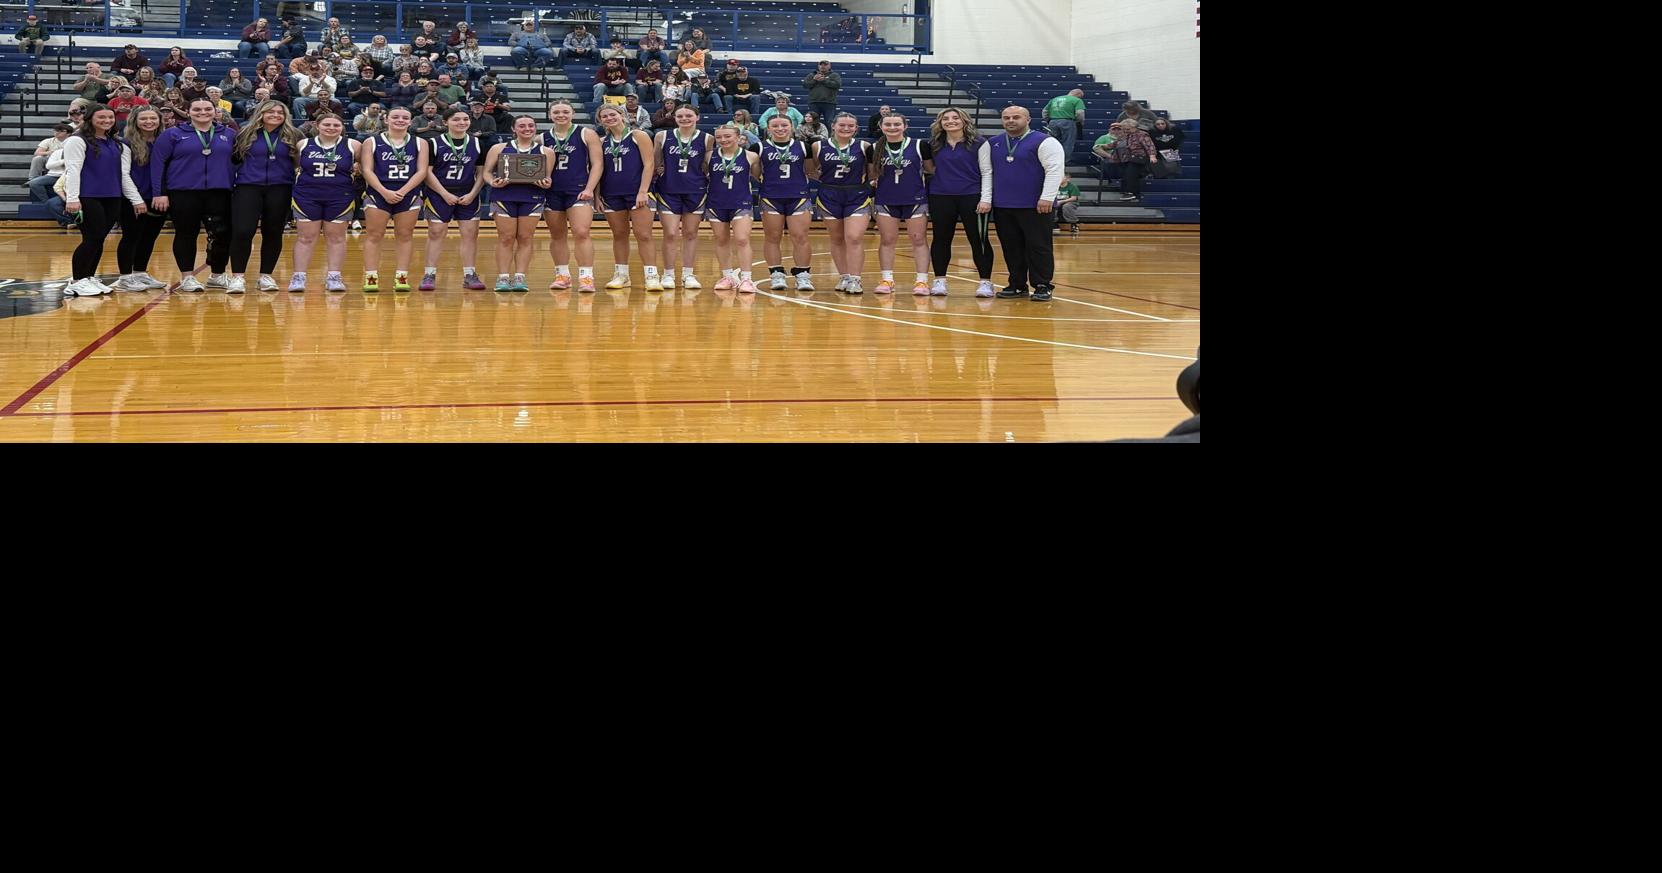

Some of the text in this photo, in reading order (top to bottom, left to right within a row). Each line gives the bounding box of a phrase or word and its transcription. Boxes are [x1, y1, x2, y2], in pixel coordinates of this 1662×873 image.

[381, 151, 414, 163] Vaey
[669, 145, 699, 158] Vaey
[312, 162, 337, 177] 32
[555, 154, 569, 170] 2
[678, 158, 689, 173] 5
[388, 164, 410, 179] 22
